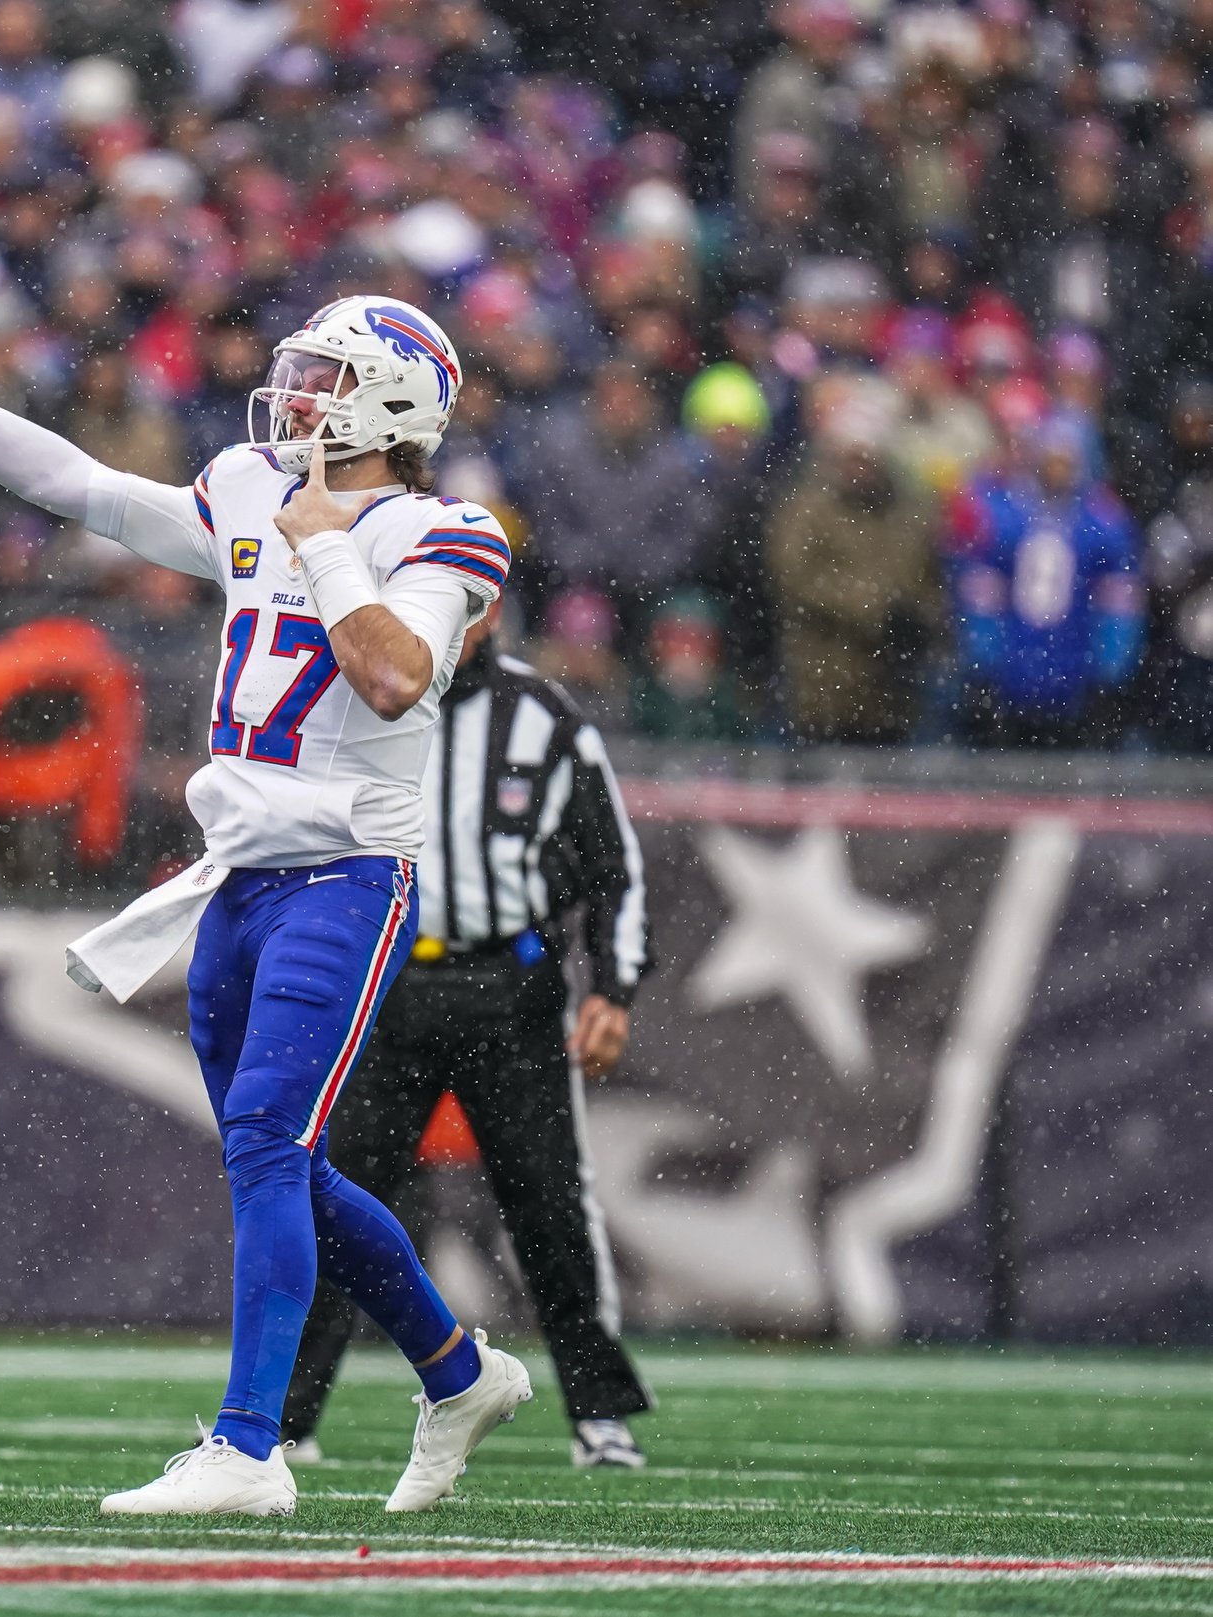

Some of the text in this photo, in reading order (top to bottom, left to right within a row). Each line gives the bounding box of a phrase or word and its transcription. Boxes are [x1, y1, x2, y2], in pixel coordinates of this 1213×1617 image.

[233, 540, 259, 568] C
[271, 592, 306, 607] BILLS
[212, 608, 341, 768] 17
